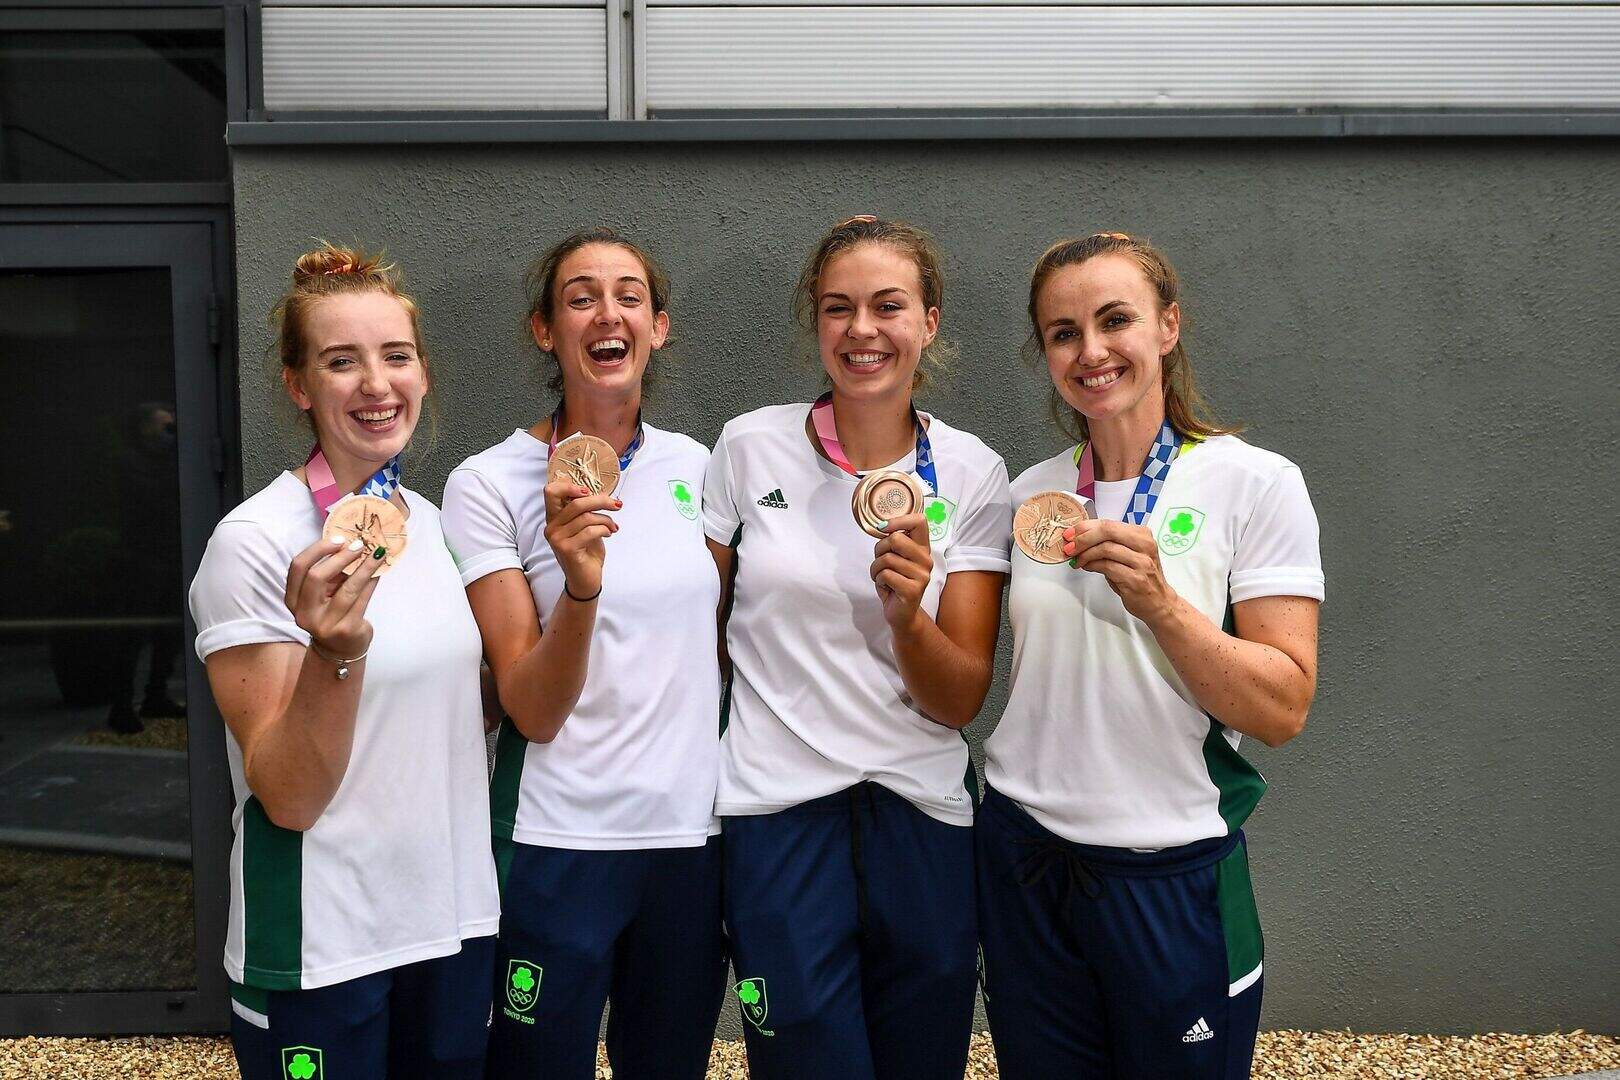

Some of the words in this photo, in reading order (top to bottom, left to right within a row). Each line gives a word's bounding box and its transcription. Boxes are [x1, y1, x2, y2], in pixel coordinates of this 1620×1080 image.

[757, 499, 789, 509] adidas
[521, 1015, 535, 1025] 2020
[1182, 1030, 1214, 1043] adidas
